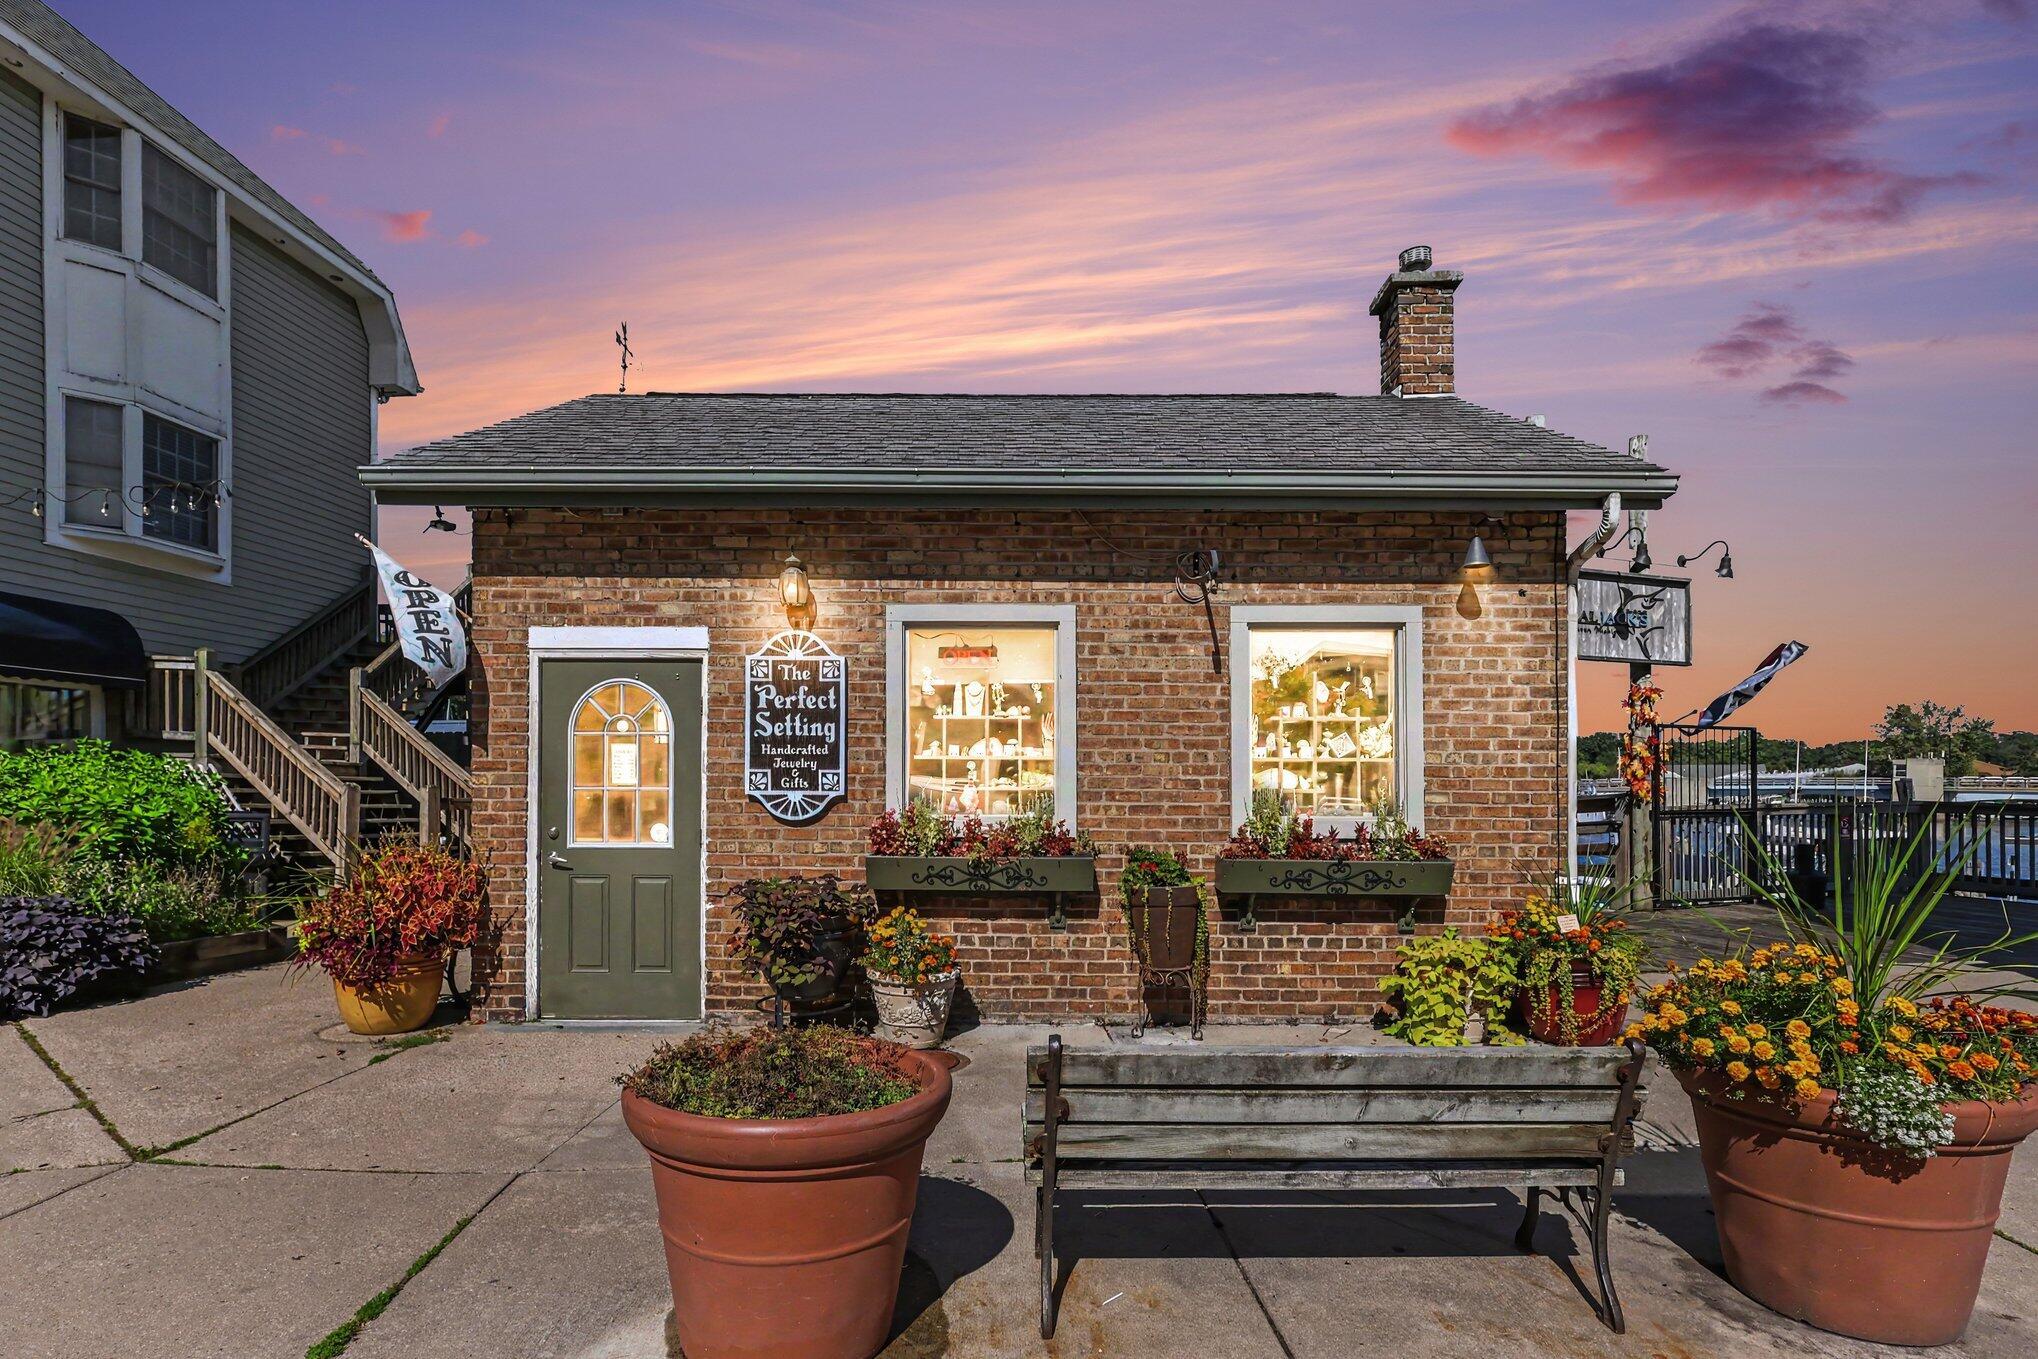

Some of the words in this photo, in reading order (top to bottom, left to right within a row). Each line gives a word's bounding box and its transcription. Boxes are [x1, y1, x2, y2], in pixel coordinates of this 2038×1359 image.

[393, 570, 453, 669] OPEN
[777, 663, 811, 681] The
[754, 684, 837, 710] Perfect
[753, 711, 836, 743] Setting
[761, 744, 829, 756] Handcrafted
[773, 757, 817, 771] Jewelry
[791, 768, 800, 778] &
[780, 777, 809, 789] Gifts
